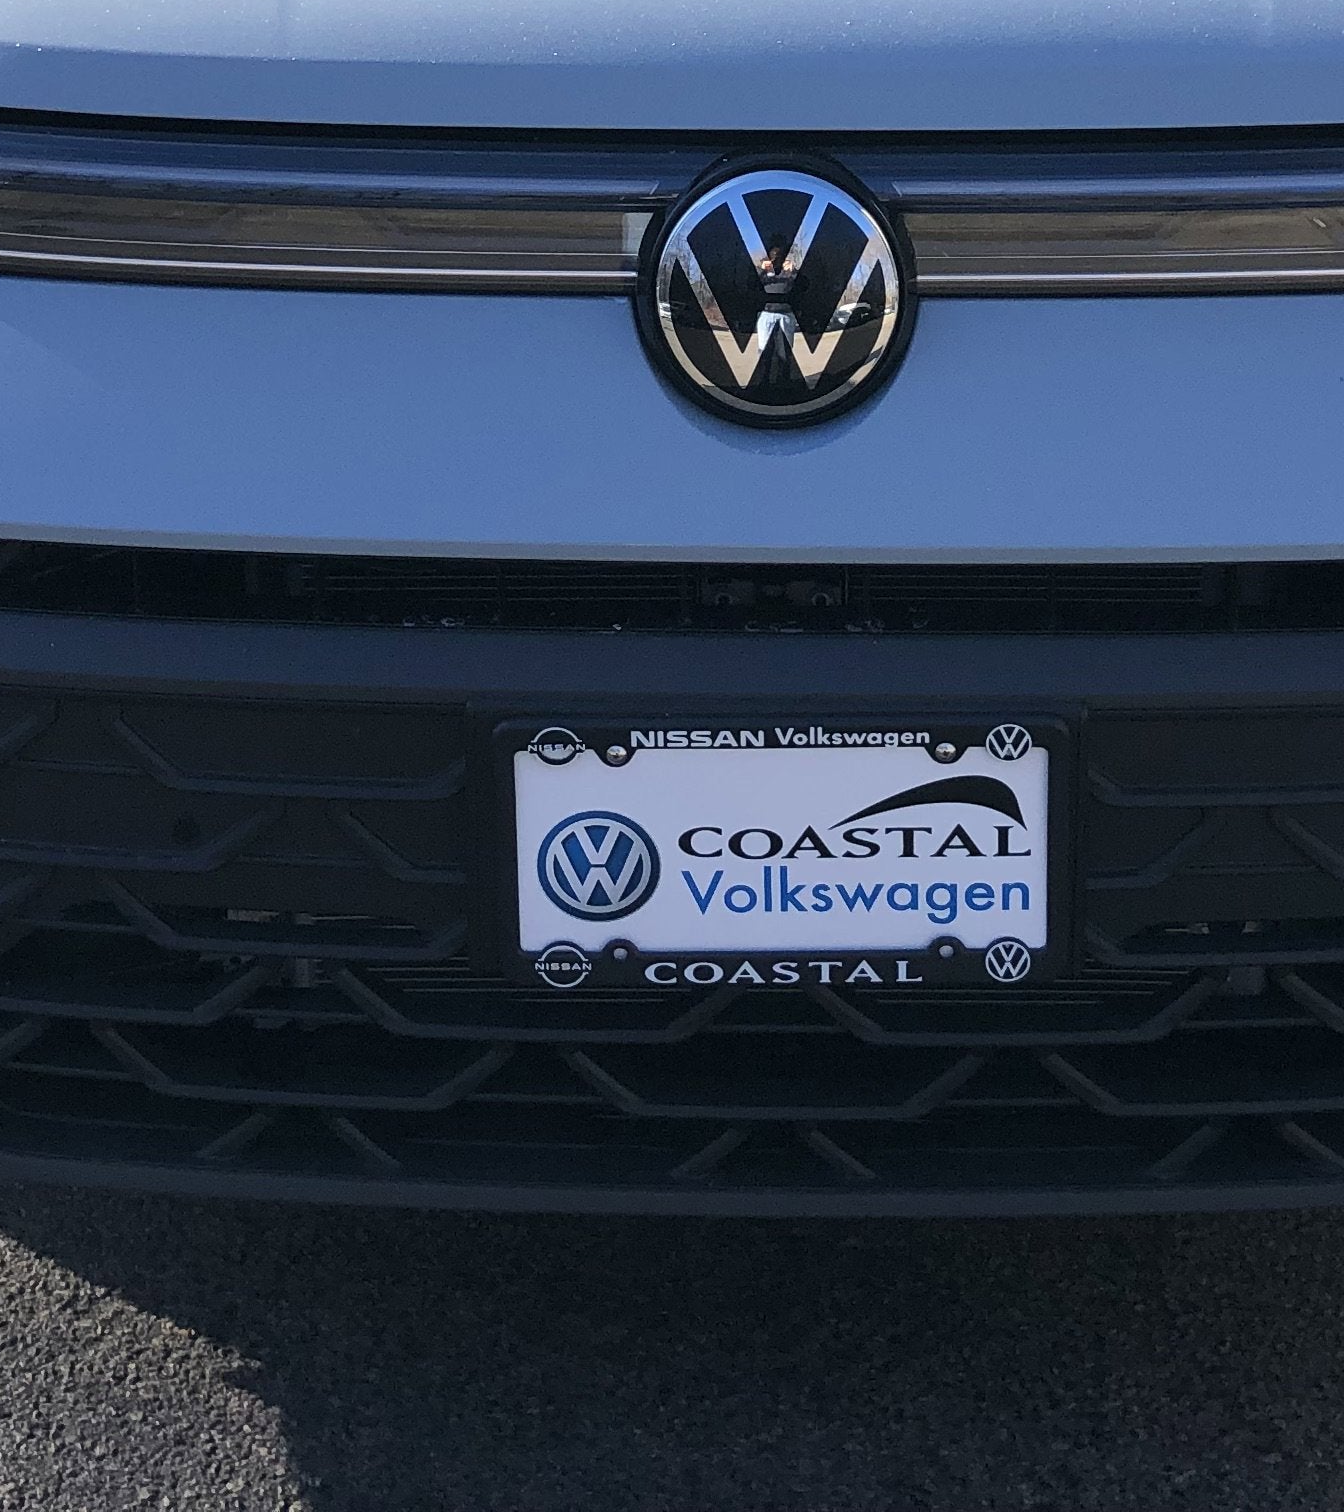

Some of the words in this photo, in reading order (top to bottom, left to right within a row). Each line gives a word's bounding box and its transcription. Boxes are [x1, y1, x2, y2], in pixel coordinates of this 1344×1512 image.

[630, 730, 764, 747] NISSAN
[774, 727, 931, 747] Volkswagen
[678, 824, 1032, 859] COASTAL
[681, 866, 1030, 924] Volkswagen
[644, 960, 923, 984] COASTAL
